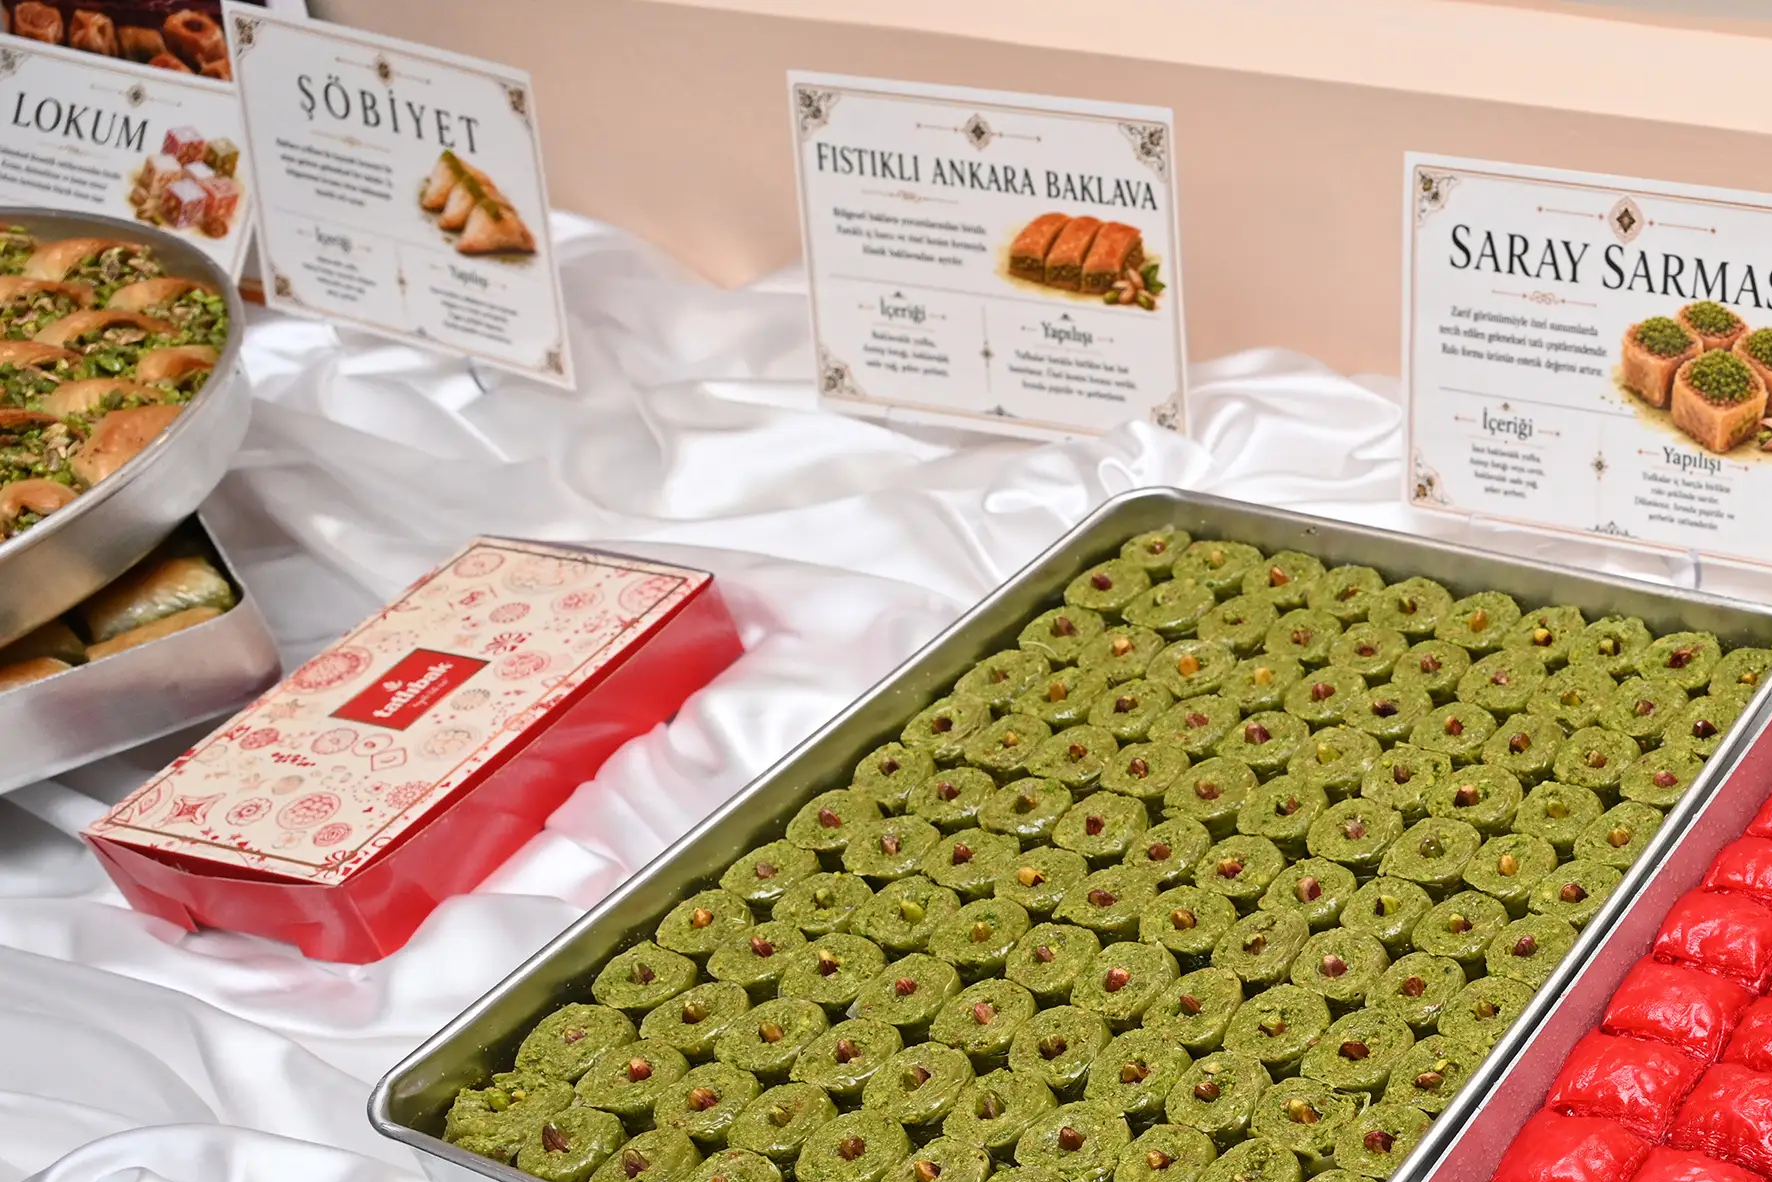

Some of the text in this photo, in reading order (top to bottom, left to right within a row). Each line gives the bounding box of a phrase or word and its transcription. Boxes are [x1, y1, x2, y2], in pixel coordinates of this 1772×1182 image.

[12, 91, 149, 153] LOKUM
[297, 74, 480, 154] ŞÖBİYET
[816, 142, 1159, 211] FISTIKLI ANKARA BAKLAVA
[1449, 223, 1591, 284] SARAY
[1482, 407, 1534, 441] İçeriği
[1663, 446, 1721, 475] Yapılışı
